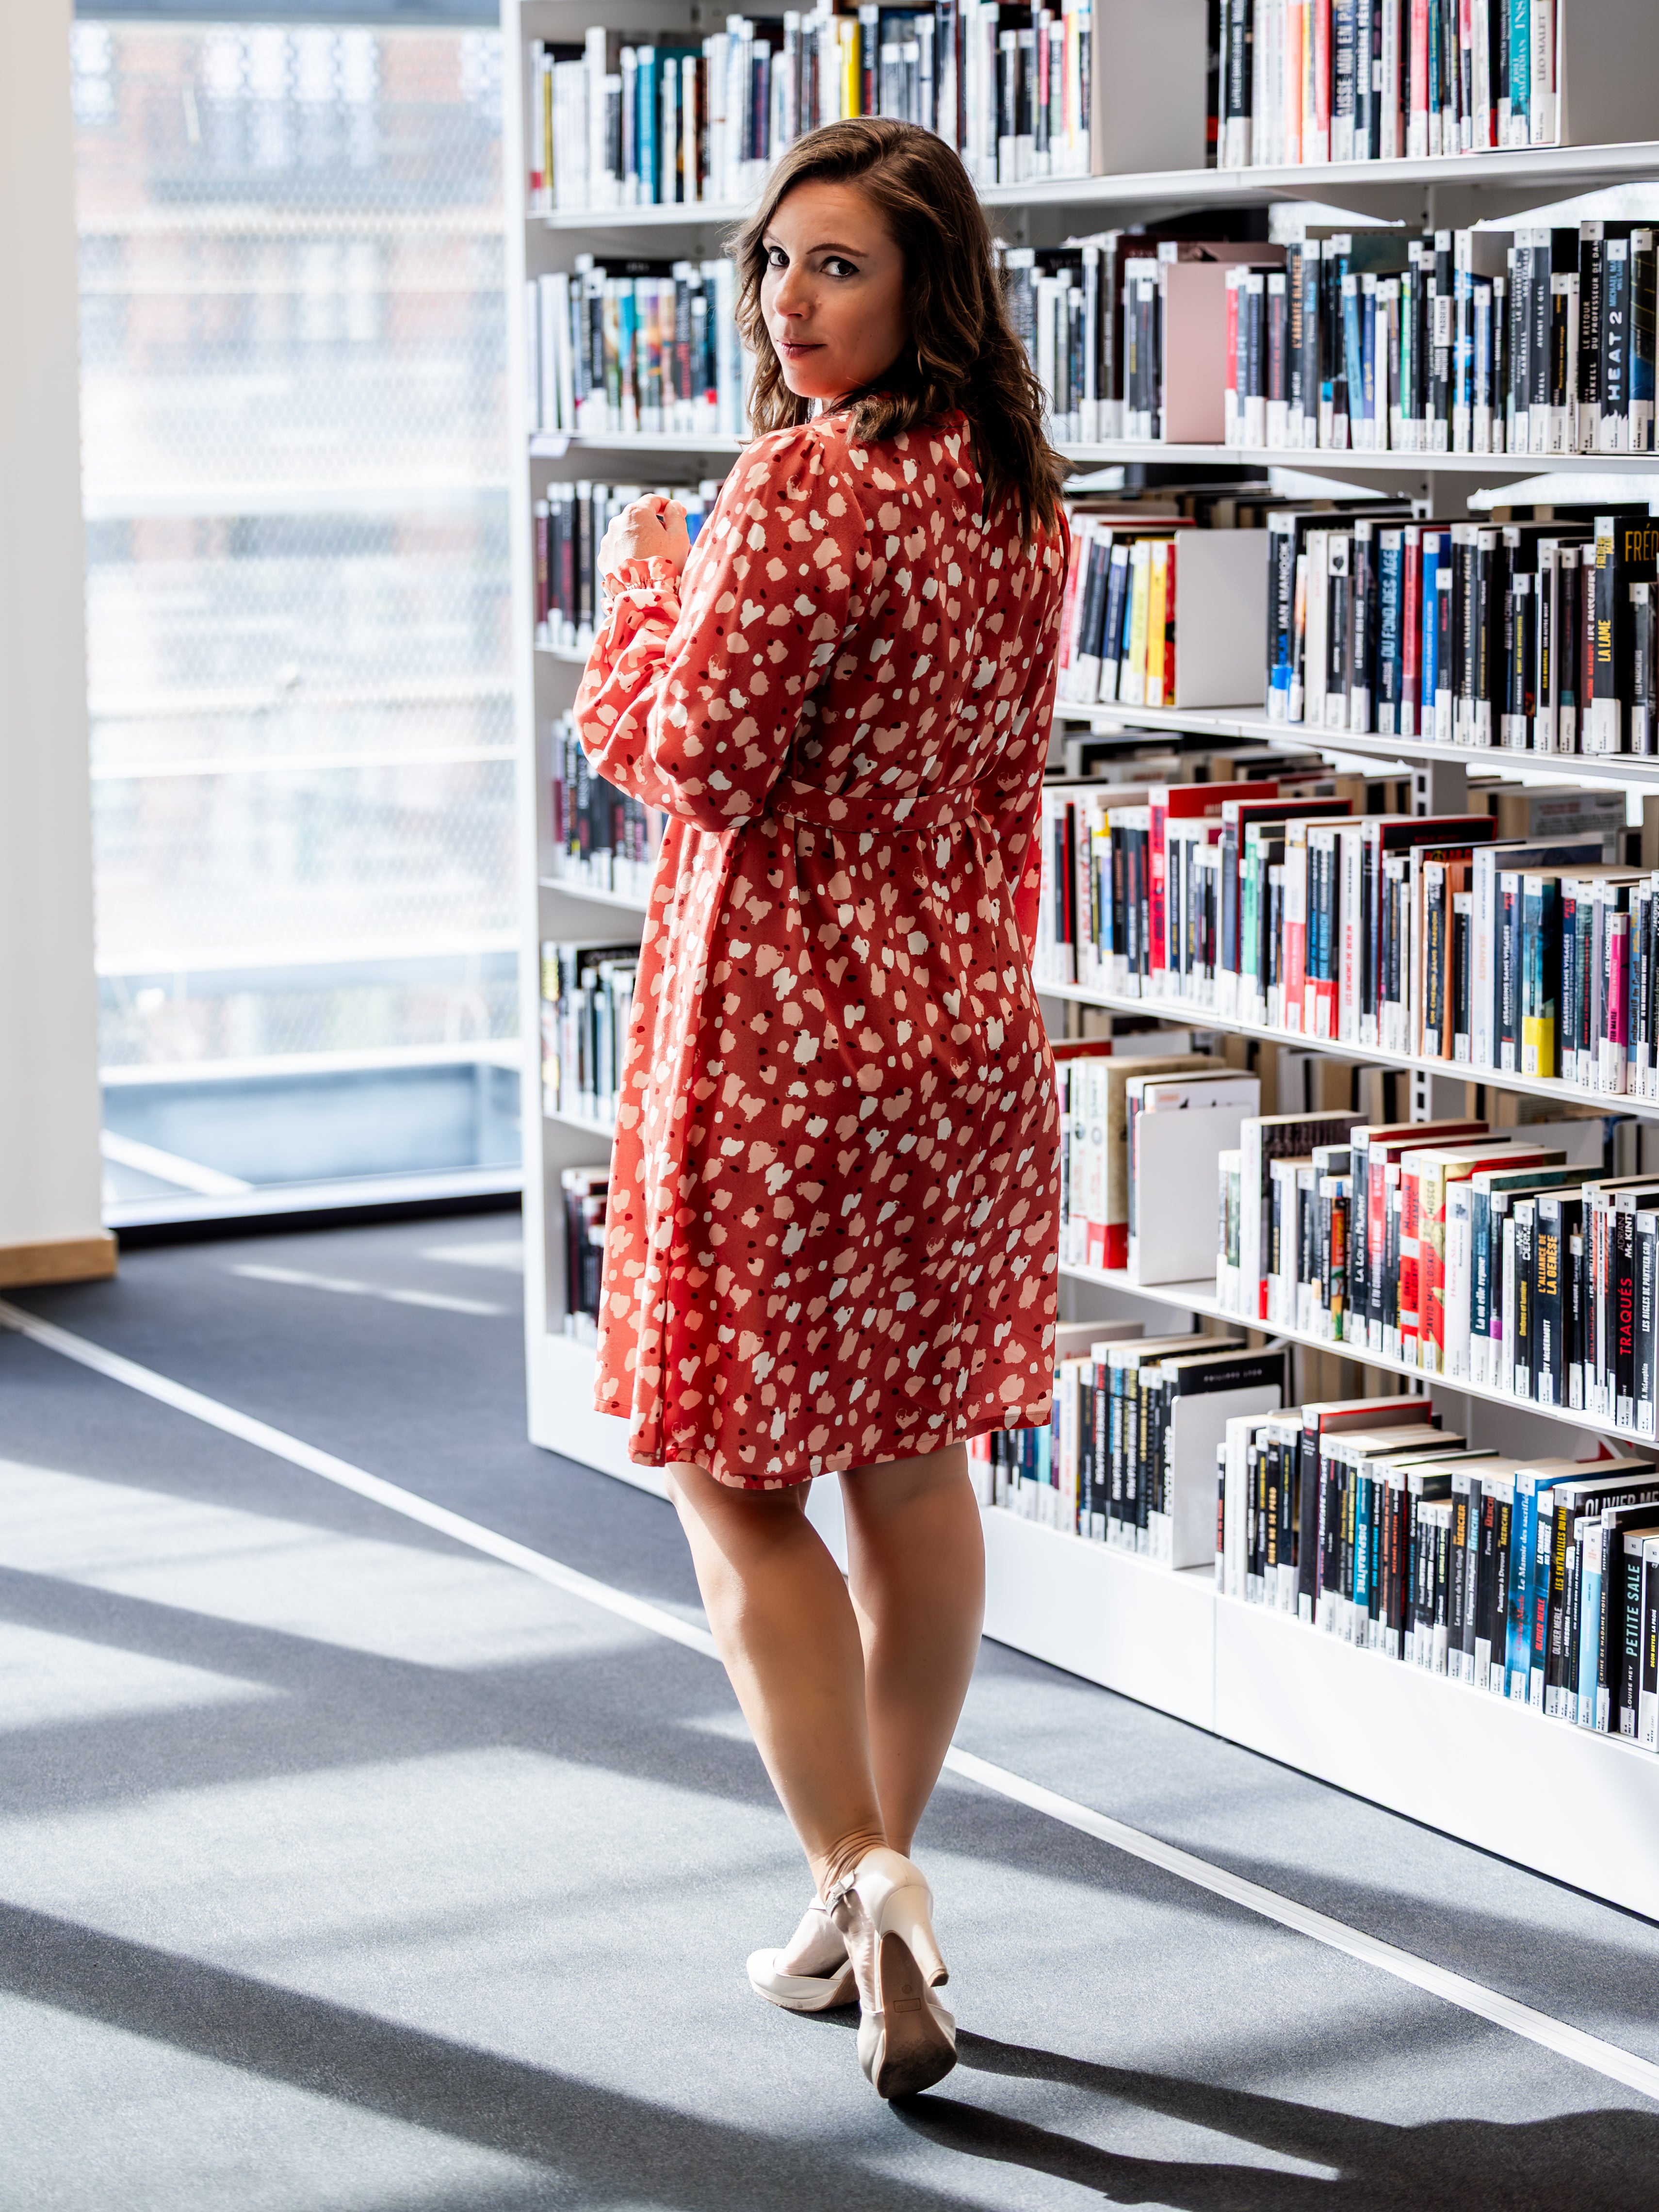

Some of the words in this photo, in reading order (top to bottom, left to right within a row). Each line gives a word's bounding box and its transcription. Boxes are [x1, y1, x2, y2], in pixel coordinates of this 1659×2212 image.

[1538, 14, 1547, 55] MALET
[1537, 59, 1546, 81] LÉO
[1336, 78, 1353, 115] AISSE
[1592, 262, 1598, 273] DE
[1537, 306, 1544, 316] LE
[1609, 311, 1622, 324] 2
[1583, 340, 1590, 349] LE
[1592, 337, 1598, 349] DU
[1608, 331, 1622, 400] HEAT
[1277, 542, 1289, 601] MANOOK
[1382, 550, 1398, 576] AGE
[1463, 553, 1471, 580] PÉCHÉ
[1381, 580, 1397, 604] DES
[1277, 604, 1289, 629] IAN
[1381, 608, 1396, 638] FOND
[1463, 599, 1471, 648] L'ILLUSION
[1597, 620, 1611, 647] LAME
[1380, 640, 1396, 658] DU
[1597, 650, 1610, 662] LA
[1478, 934, 1487, 981] ASPHYXIE
[1403, 1185, 1412, 1230] MISSION
[1426, 1181, 1435, 1215] MOSCO
[1515, 1230, 1523, 1245] Mc
[1538, 1234, 1546, 1245] DE
[1626, 1243, 1632, 1258] Mc
[1537, 1246, 1546, 1293] L'ALLIANCE
[1545, 1235, 1558, 1278] GENÈSE
[1426, 1245, 1434, 1301] McCLOSKEY
[1476, 1256, 1487, 1286] repose
[1475, 1287, 1485, 1304] elle
[1519, 1281, 1528, 1304] lumière
[1547, 1281, 1557, 1295] LA
[1475, 1319, 1485, 1330] Là
[1519, 1313, 1528, 1336] Ombres
[1618, 1278, 1632, 1355] TRAQUÉS
[1483, 1497, 1494, 1528] MERCIE
[1520, 1494, 1529, 1527] sacrifié
[1456, 1504, 1465, 1546] MERCIER
[1470, 1508, 1479, 1550] MERCIER
[1499, 1507, 1508, 1545] MERCIER
[1537, 1520, 1545, 1554] CHAMBRE
[1558, 1521, 1566, 1531] DU
[1356, 1523, 1367, 1594] DISPARAÎTRE
[1518, 1545, 1526, 1577] Manoir
[1536, 1555, 1544, 1565] LA
[1555, 1532, 1566, 1575] ENTRAILLES
[1517, 1578, 1525, 1591] Le
[1554, 1578, 1564, 1590] LES
[1627, 1564, 1640, 1601] SALE
[1454, 1618, 1461, 1626] Le
[1536, 1598, 1545, 1622] MERLE
[1553, 1607, 1562, 1629] MERLE
[1515, 1621, 1524, 1651] Olivier
[1535, 1623, 1544, 1651] OLIVIER
[1552, 1630, 1561, 1655] OLIVIER
[1626, 1606, 1639, 1657] PETITE
[1600, 1648, 1604, 1657] DE
